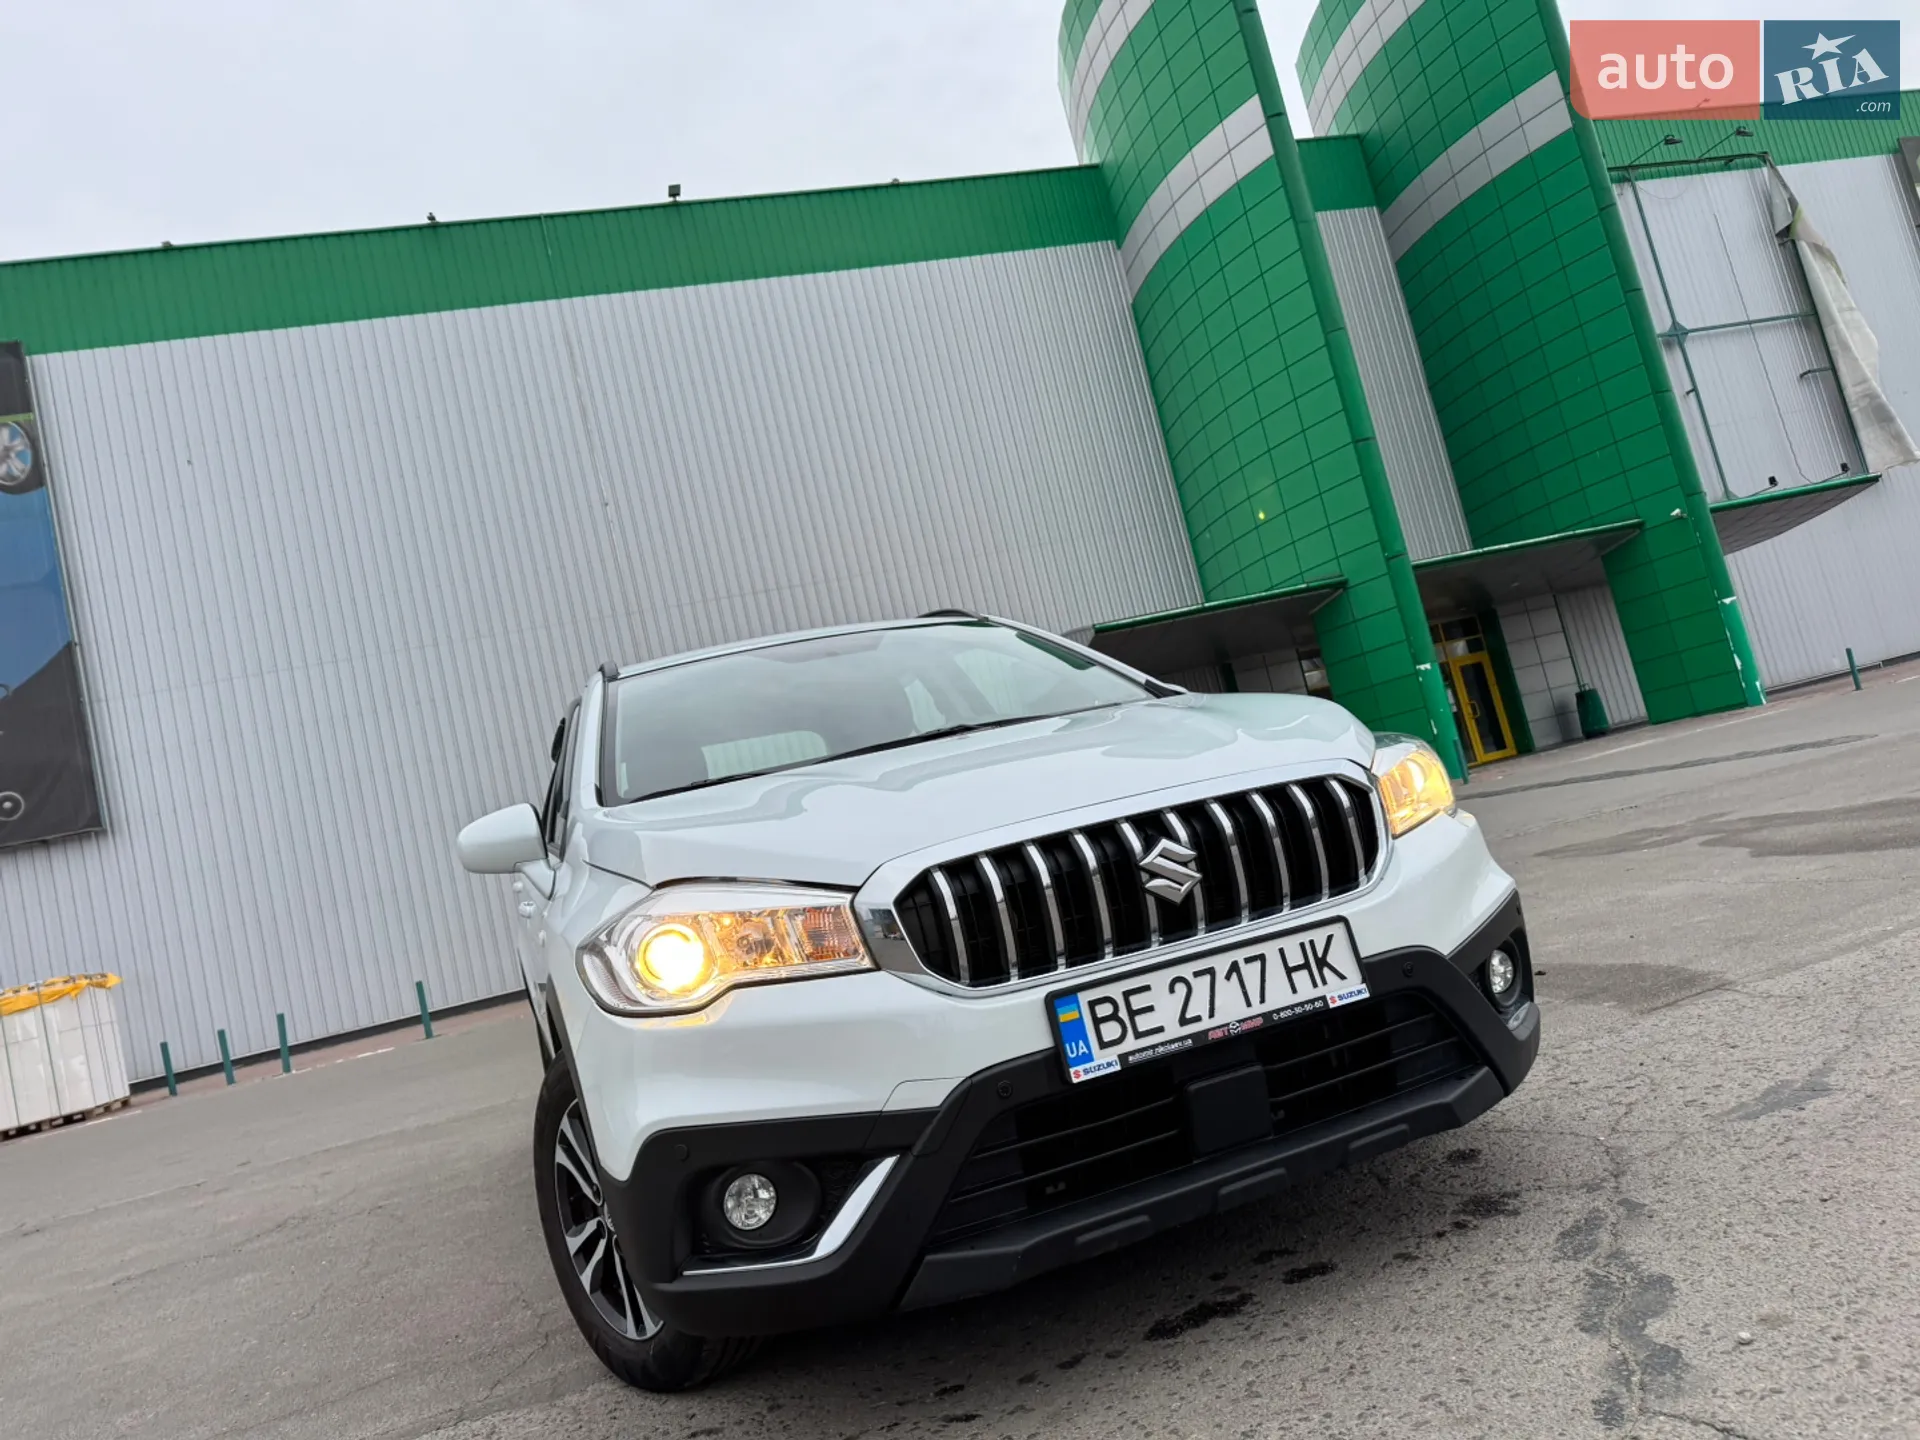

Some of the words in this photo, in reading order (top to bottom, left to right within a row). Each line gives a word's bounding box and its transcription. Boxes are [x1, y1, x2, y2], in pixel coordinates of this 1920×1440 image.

[1086, 984, 1165, 1051] BE
[1168, 952, 1267, 1028] 2717
[1278, 933, 1348, 995] HK
[1337, 987, 1368, 1001] SUZUKI
[1066, 1039, 1089, 1059] UA
[1082, 1059, 1119, 1076] SUZUKI
